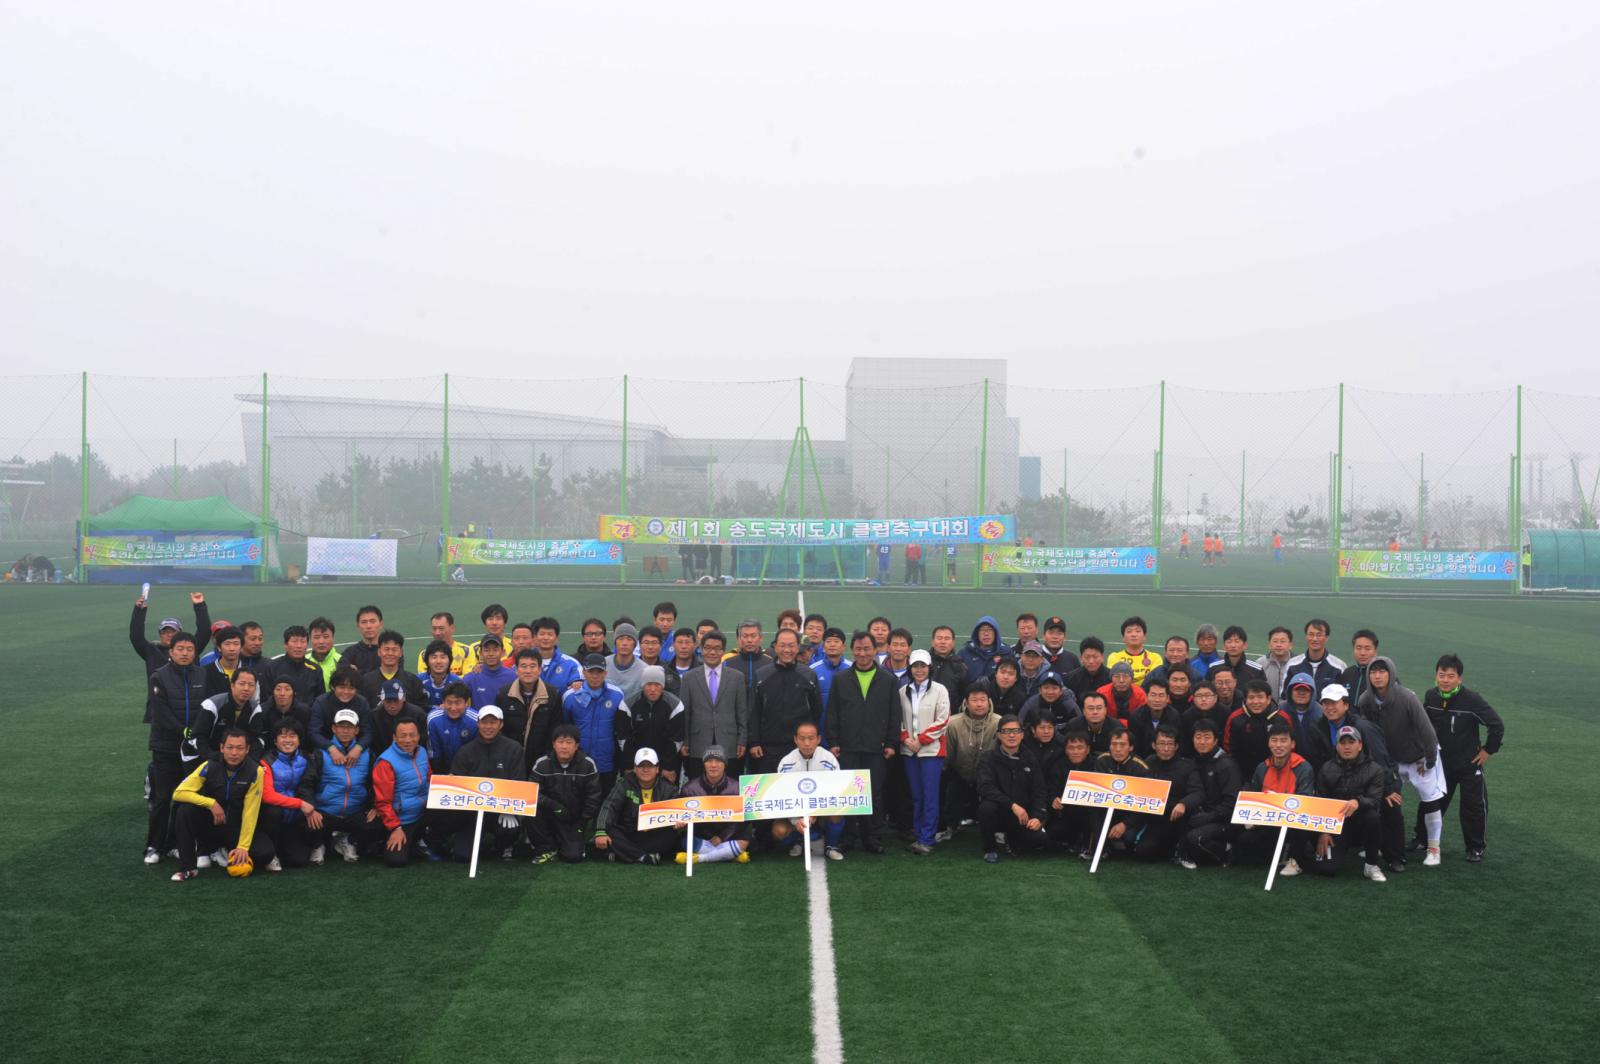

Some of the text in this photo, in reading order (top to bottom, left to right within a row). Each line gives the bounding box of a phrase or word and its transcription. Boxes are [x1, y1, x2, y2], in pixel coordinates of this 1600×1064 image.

[667, 519, 969, 538] 제1회 송도국제도시 클럽축구대회
[440, 794, 527, 812] 송연FC축구단
[744, 796, 869, 813] 송도국제도시 클럽축구대회
[1067, 789, 1162, 811] 미카엘FC축구단
[649, 809, 733, 825] FC신송축구단
[1238, 809, 1338, 831] 엑스포FC축구단
